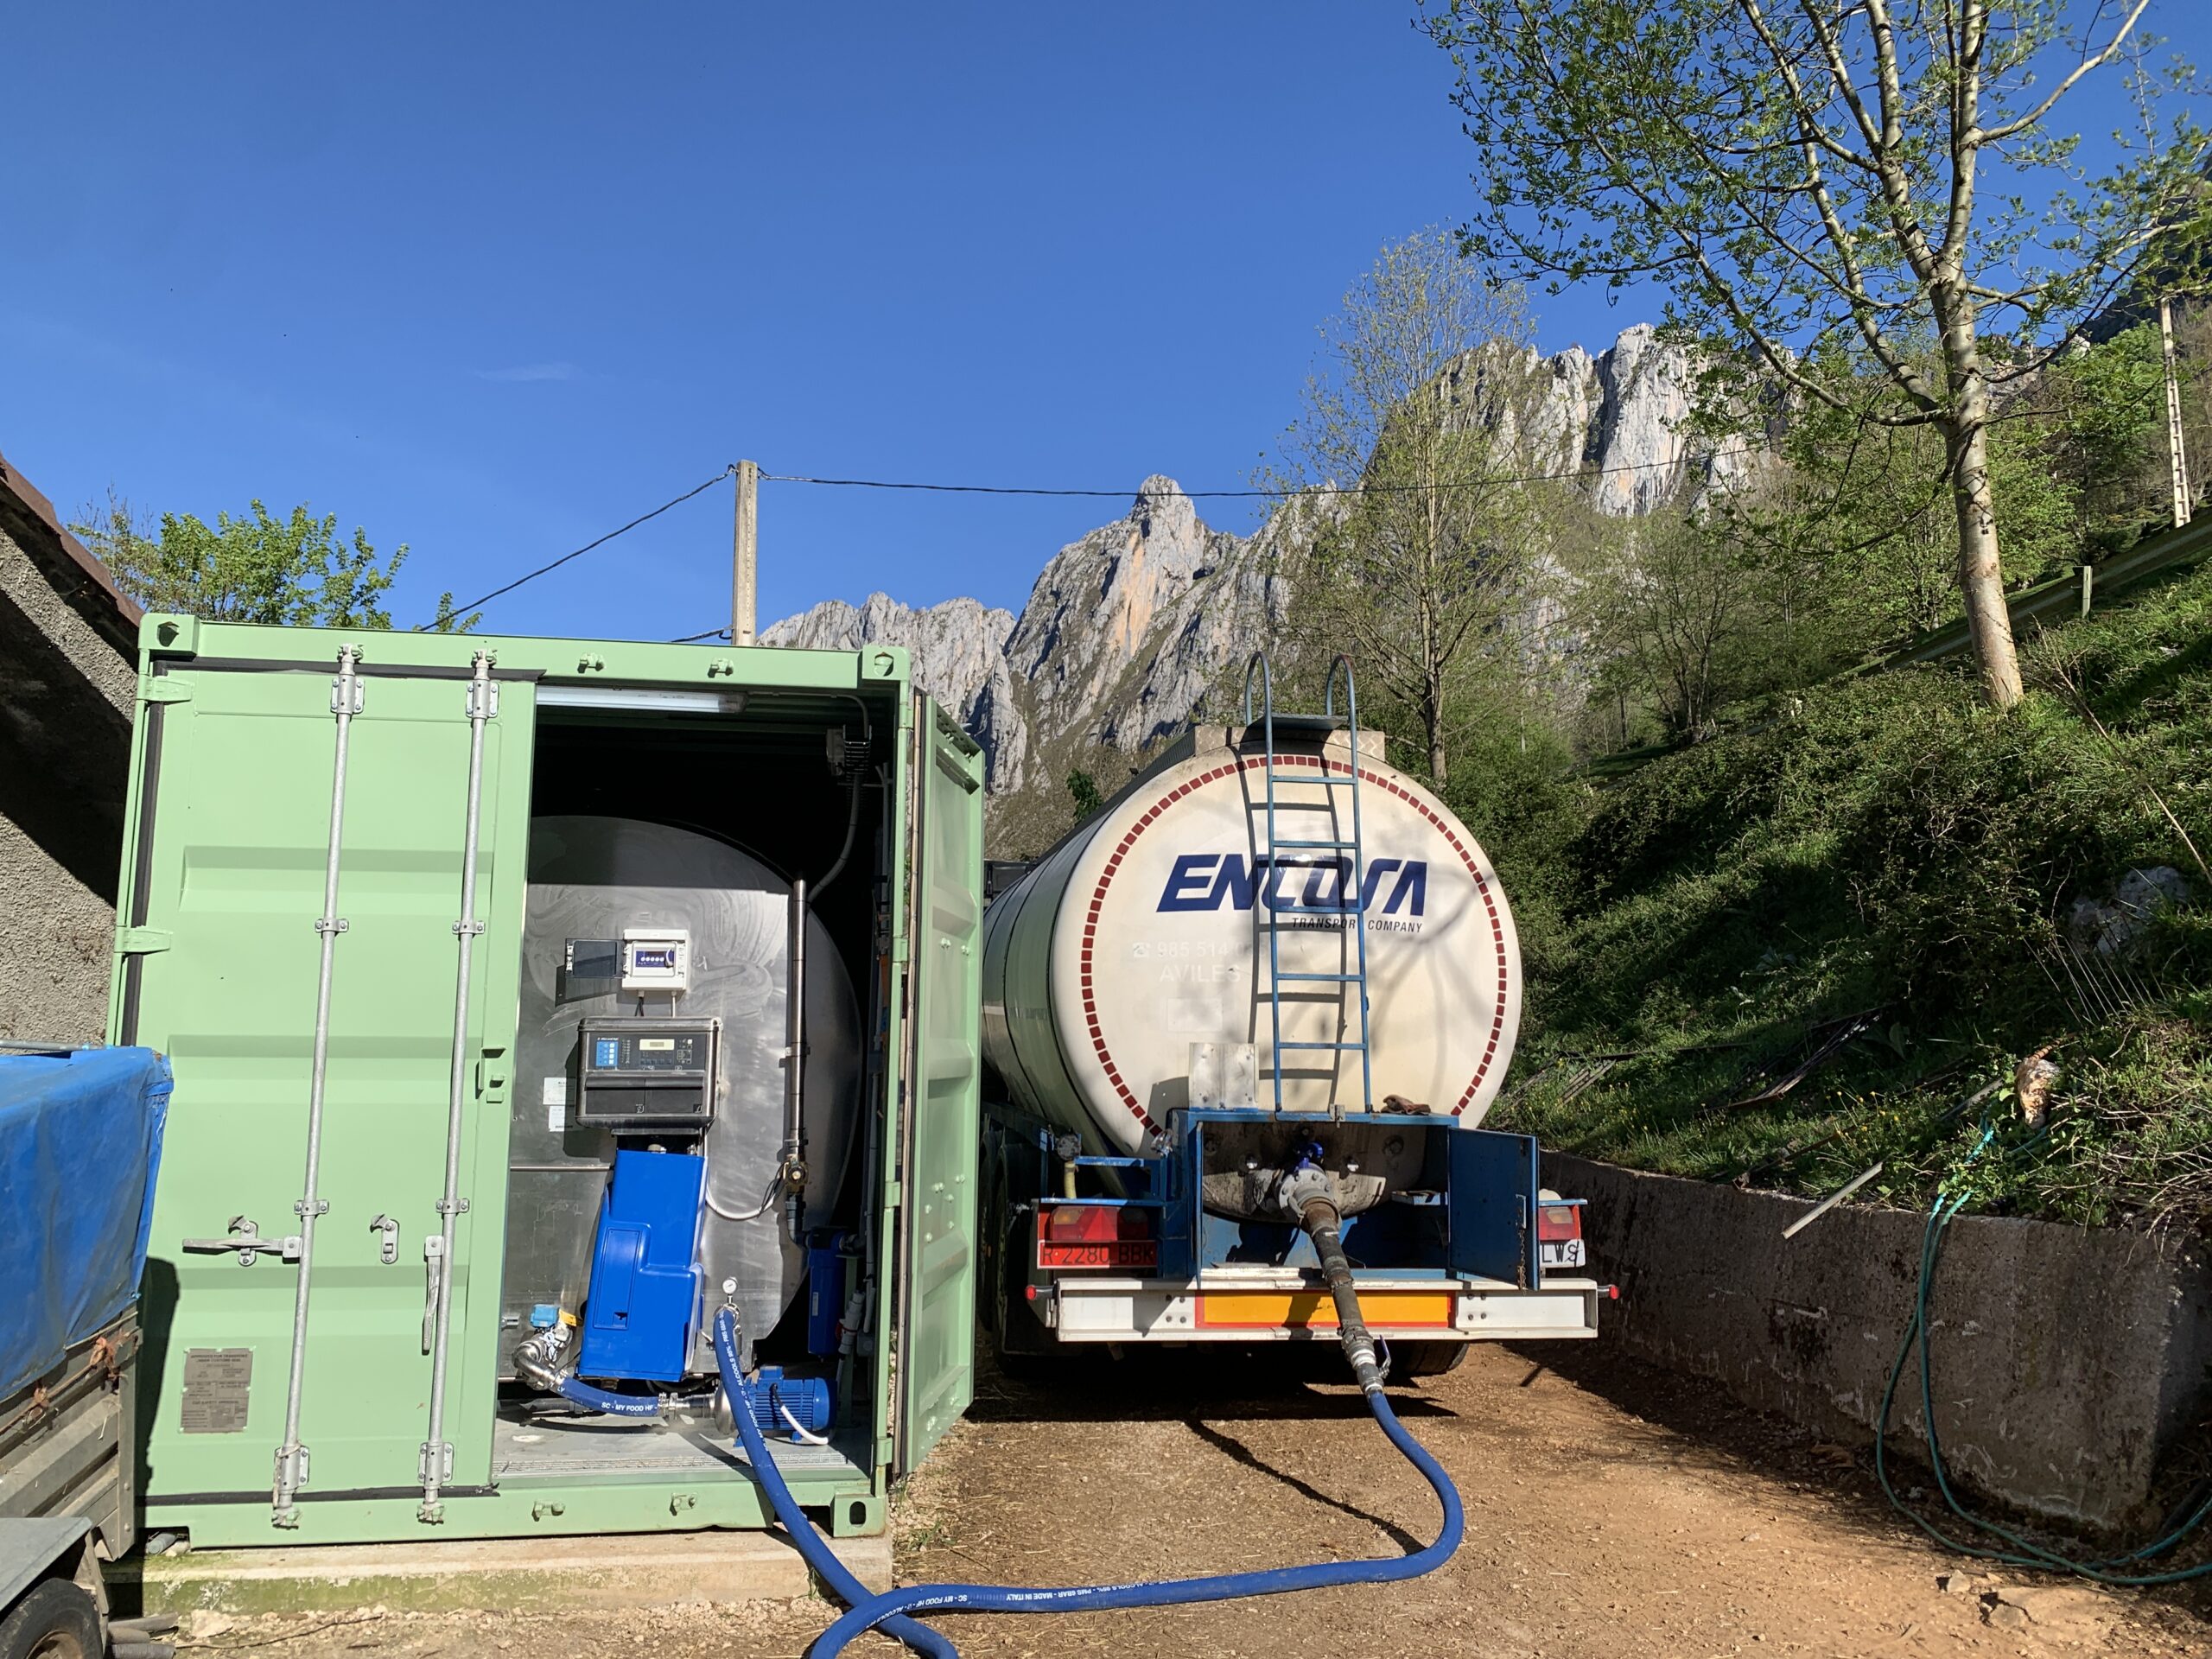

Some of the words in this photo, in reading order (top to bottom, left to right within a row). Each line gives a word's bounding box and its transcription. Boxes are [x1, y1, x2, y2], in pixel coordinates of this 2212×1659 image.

[1292, 917, 1357, 929] TRANSPOR
[1368, 919, 1422, 932] COMPANY
[1160, 964, 1241, 982] AVILES
[1043, 1244, 1052, 1263] R
[1063, 1244, 1110, 1263] 2280
[1119, 1244, 1156, 1264] BBK
[1033, 1592, 1053, 1600] MADE
[1077, 1587, 1092, 1596] PMS
[925, 1597, 943, 1605] FOOD
